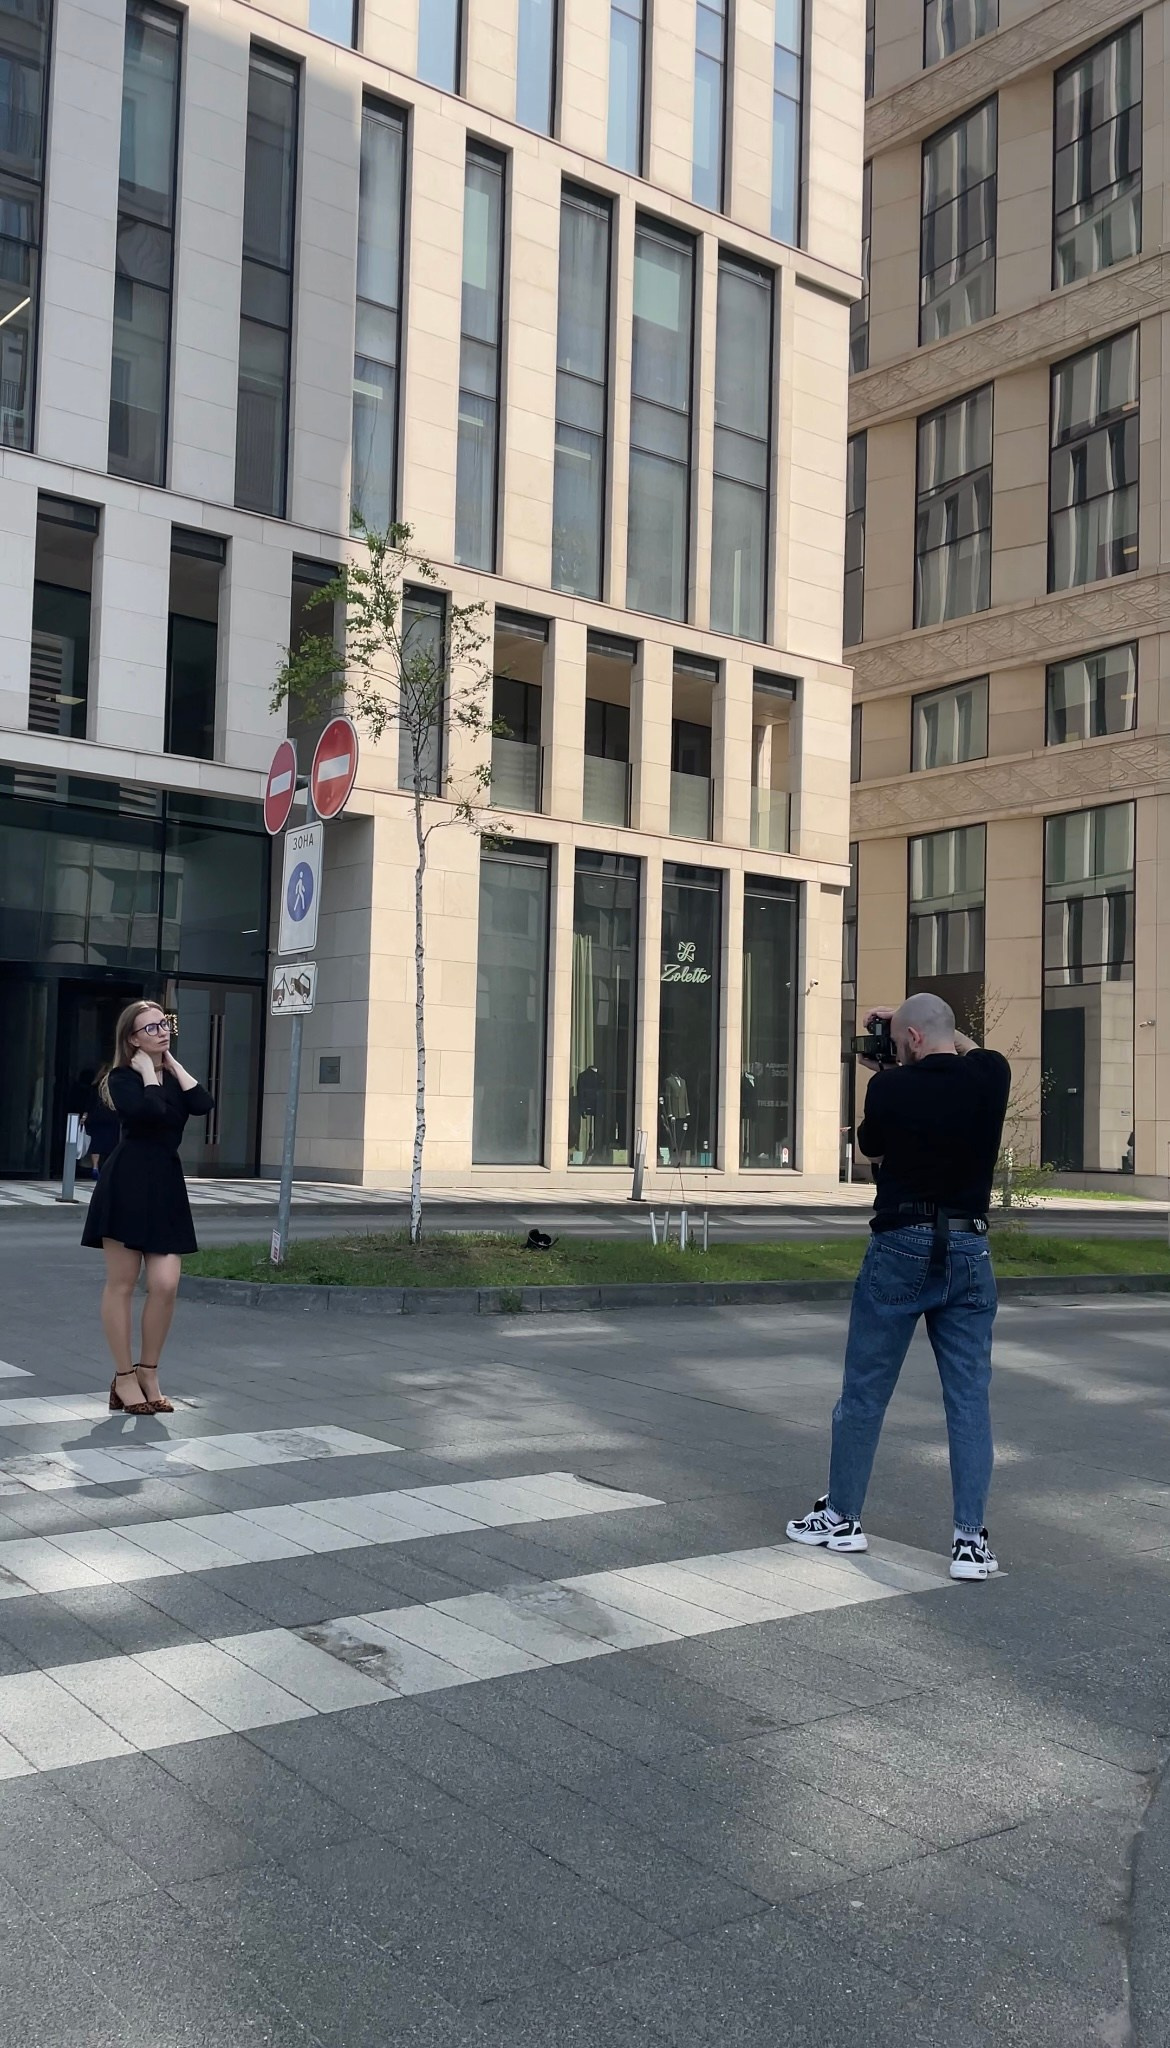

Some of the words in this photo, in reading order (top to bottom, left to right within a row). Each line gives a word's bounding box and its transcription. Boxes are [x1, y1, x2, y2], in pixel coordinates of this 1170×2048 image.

[293, 833, 313, 850] ЗОНА
[661, 964, 711, 983] Zoletto
[814, 1519, 823, 1530] N
